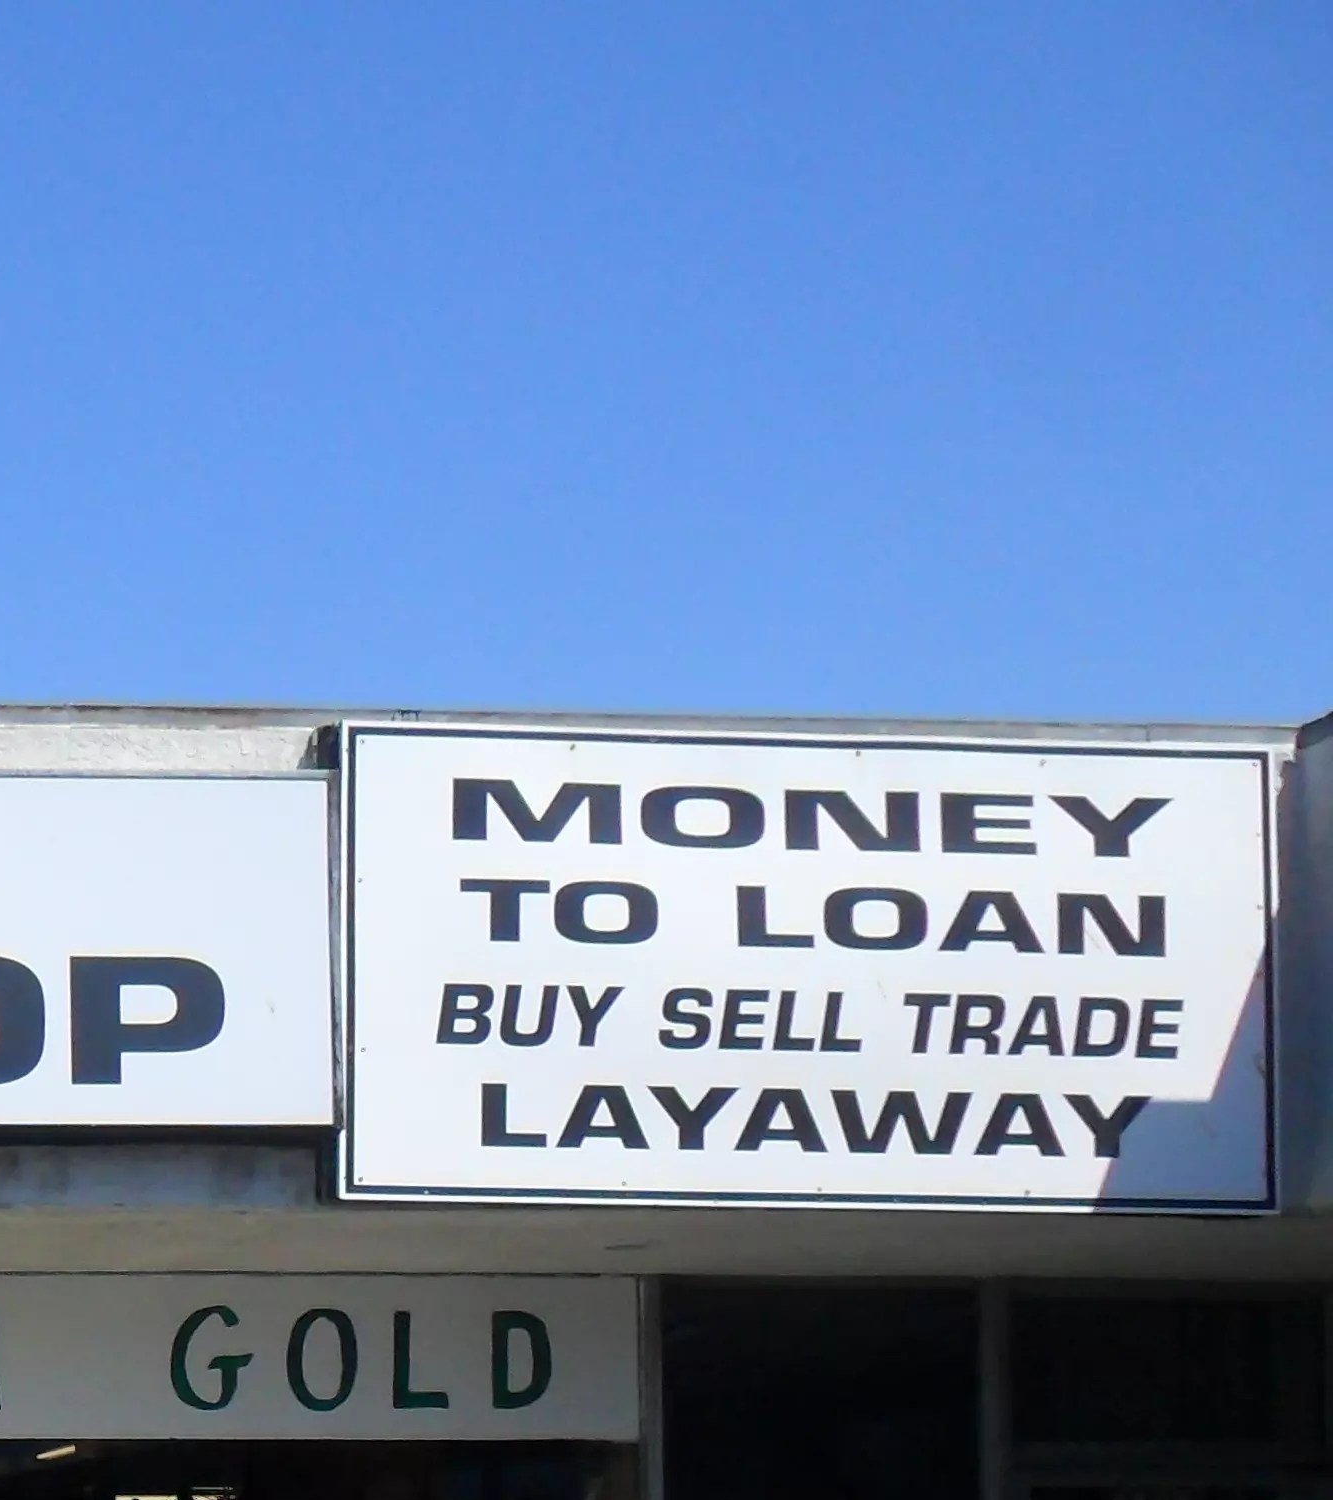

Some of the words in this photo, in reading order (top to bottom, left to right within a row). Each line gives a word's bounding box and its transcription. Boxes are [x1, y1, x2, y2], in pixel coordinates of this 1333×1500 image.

[452, 777, 1174, 857] MONEY
[460, 878, 658, 944] TO
[736, 885, 1166, 957] LOAN
[436, 984, 624, 1047] BUY
[659, 988, 861, 1053] SELL
[904, 992, 1183, 1060] TRADE
[480, 1083, 1151, 1158] LAYAWAY
[170, 1305, 552, 1412] GOLD
